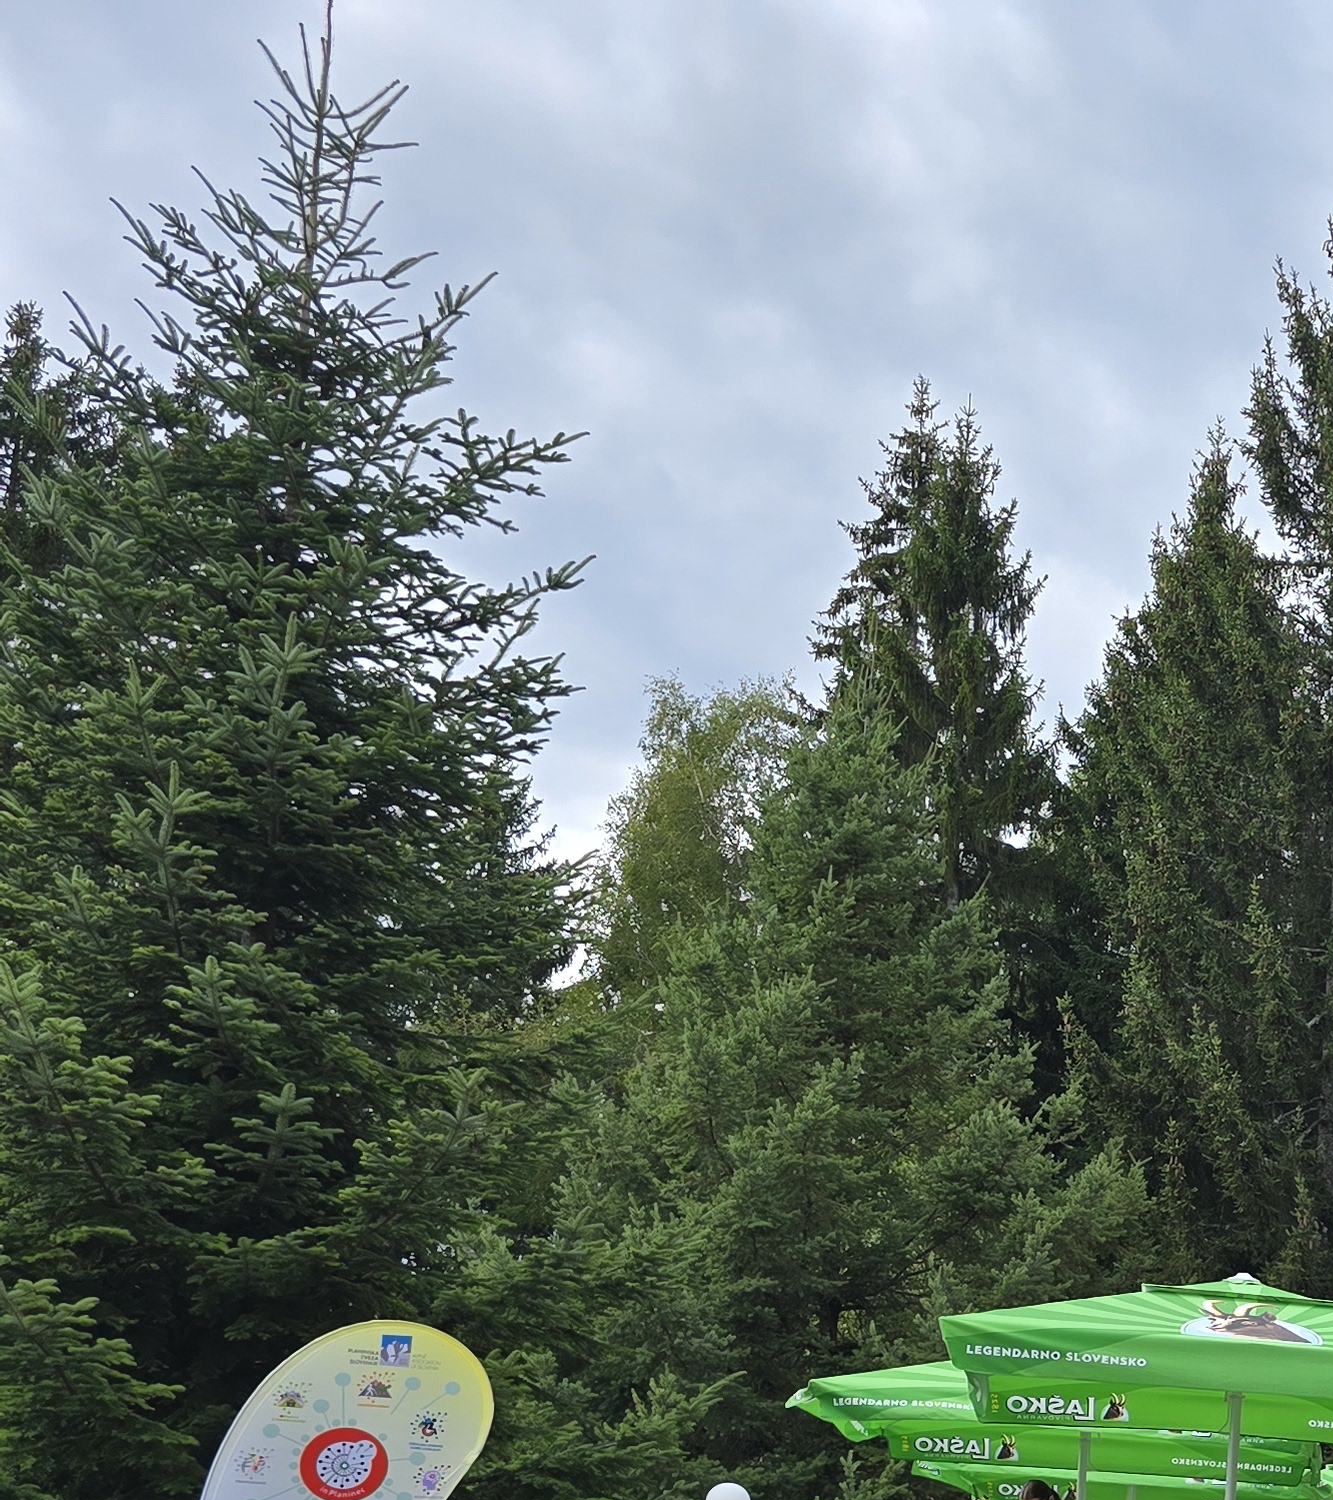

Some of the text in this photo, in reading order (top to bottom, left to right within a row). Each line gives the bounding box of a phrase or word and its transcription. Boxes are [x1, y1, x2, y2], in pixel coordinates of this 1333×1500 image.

[966, 1344, 1148, 1368] LEGENDARNO SLOVENSKO
[833, 1397, 909, 1407] LEGENDARNO
[328, 1487, 366, 1498] Planinec
